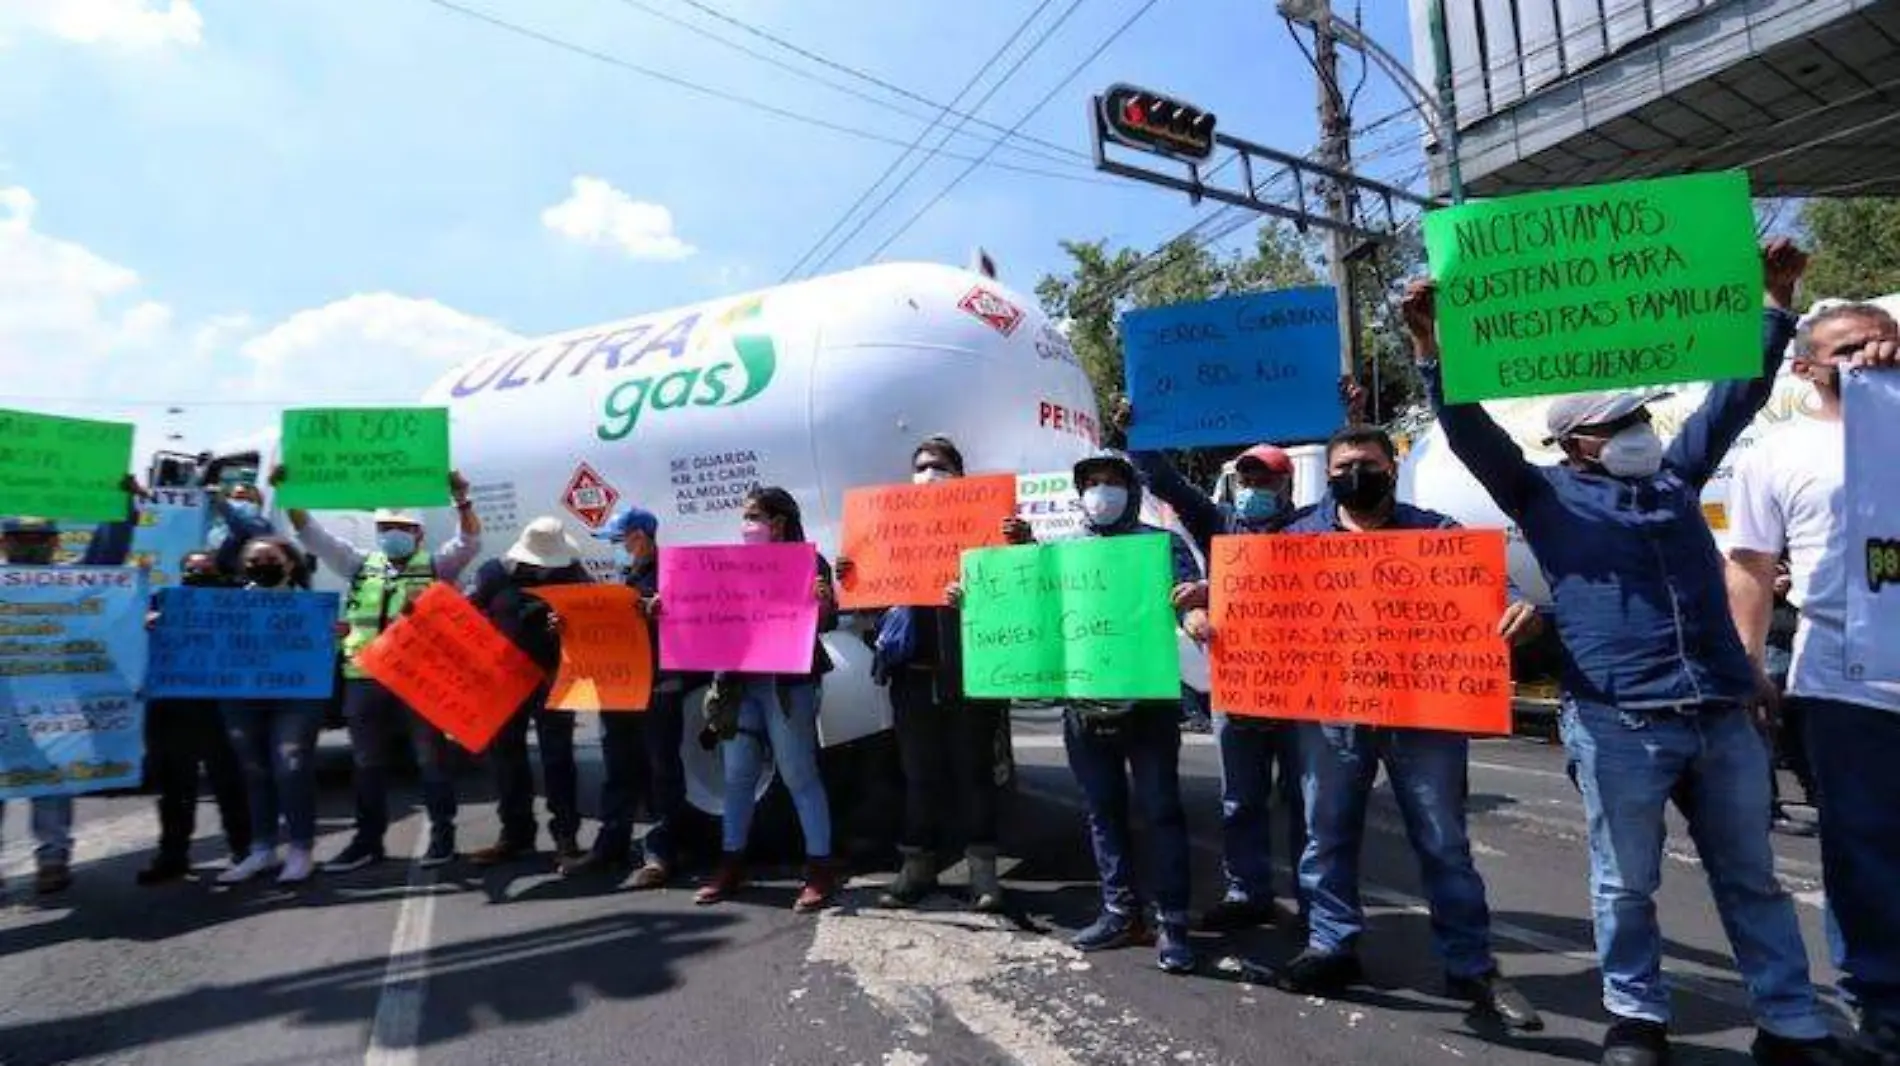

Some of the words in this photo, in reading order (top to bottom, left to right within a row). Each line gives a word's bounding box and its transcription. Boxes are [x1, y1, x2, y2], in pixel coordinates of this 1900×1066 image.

[1448, 257, 1599, 306] SUSTENTO
[1609, 244, 1688, 282] PARA
[1473, 300, 1619, 345] NUESTRAS
[1627, 282, 1751, 320] FAMILIAS
[450, 312, 704, 398] ULTRA
[1417, 535, 1473, 558] DATE
[1332, 600, 1359, 623] AL
[1372, 600, 1461, 624] PUEBLO
